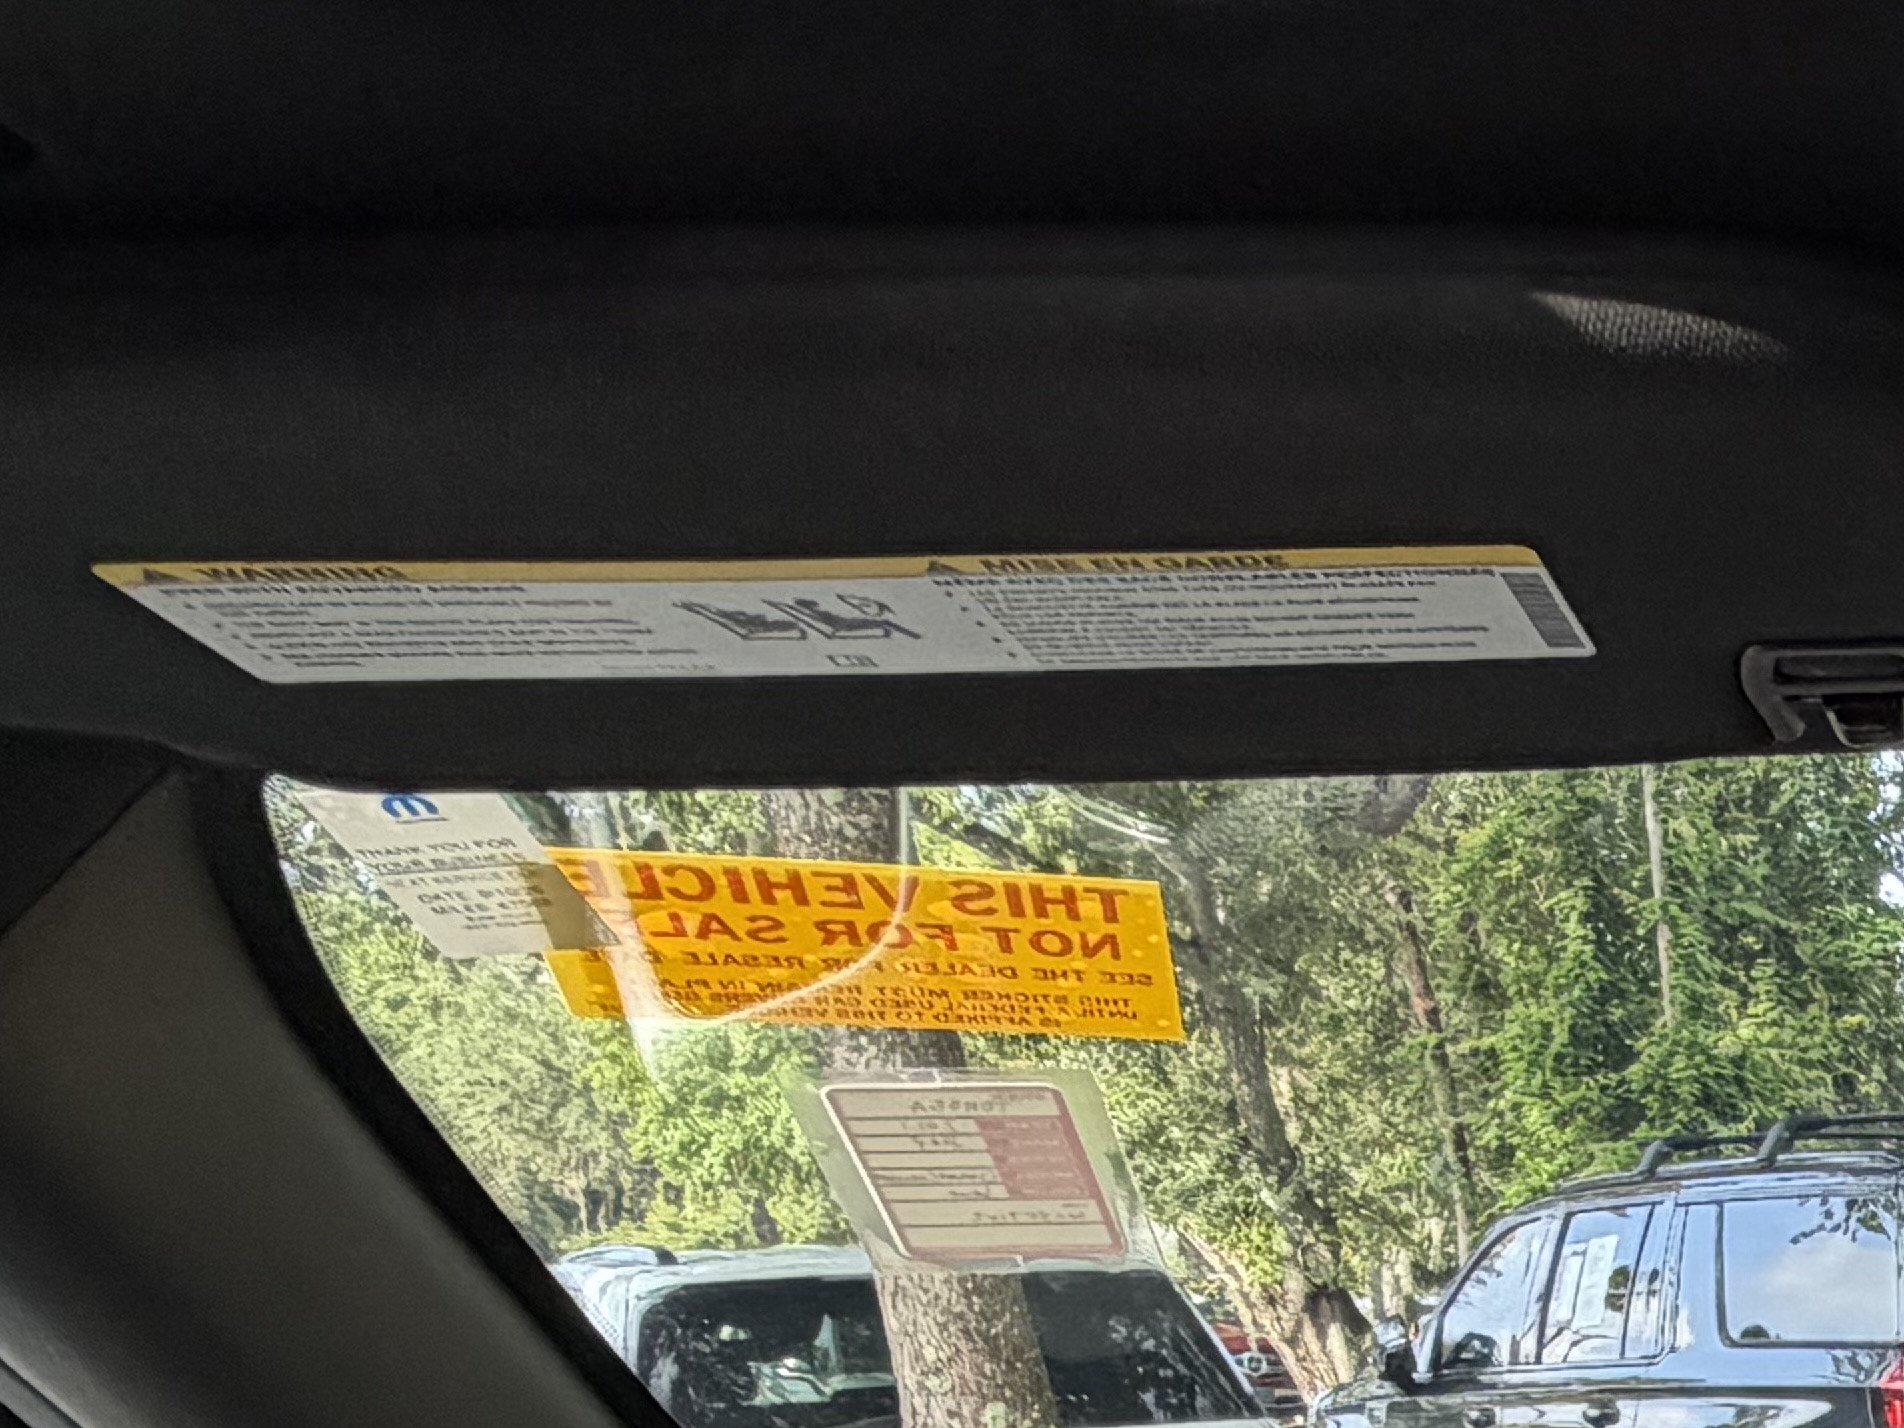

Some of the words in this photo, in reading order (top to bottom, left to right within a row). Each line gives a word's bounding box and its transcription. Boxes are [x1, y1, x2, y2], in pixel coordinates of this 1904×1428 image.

[979, 558, 1080, 573] MISE
[1098, 556, 1140, 571] EN
[1151, 554, 1288, 570] GARDE
[192, 565, 412, 583] WARNING
